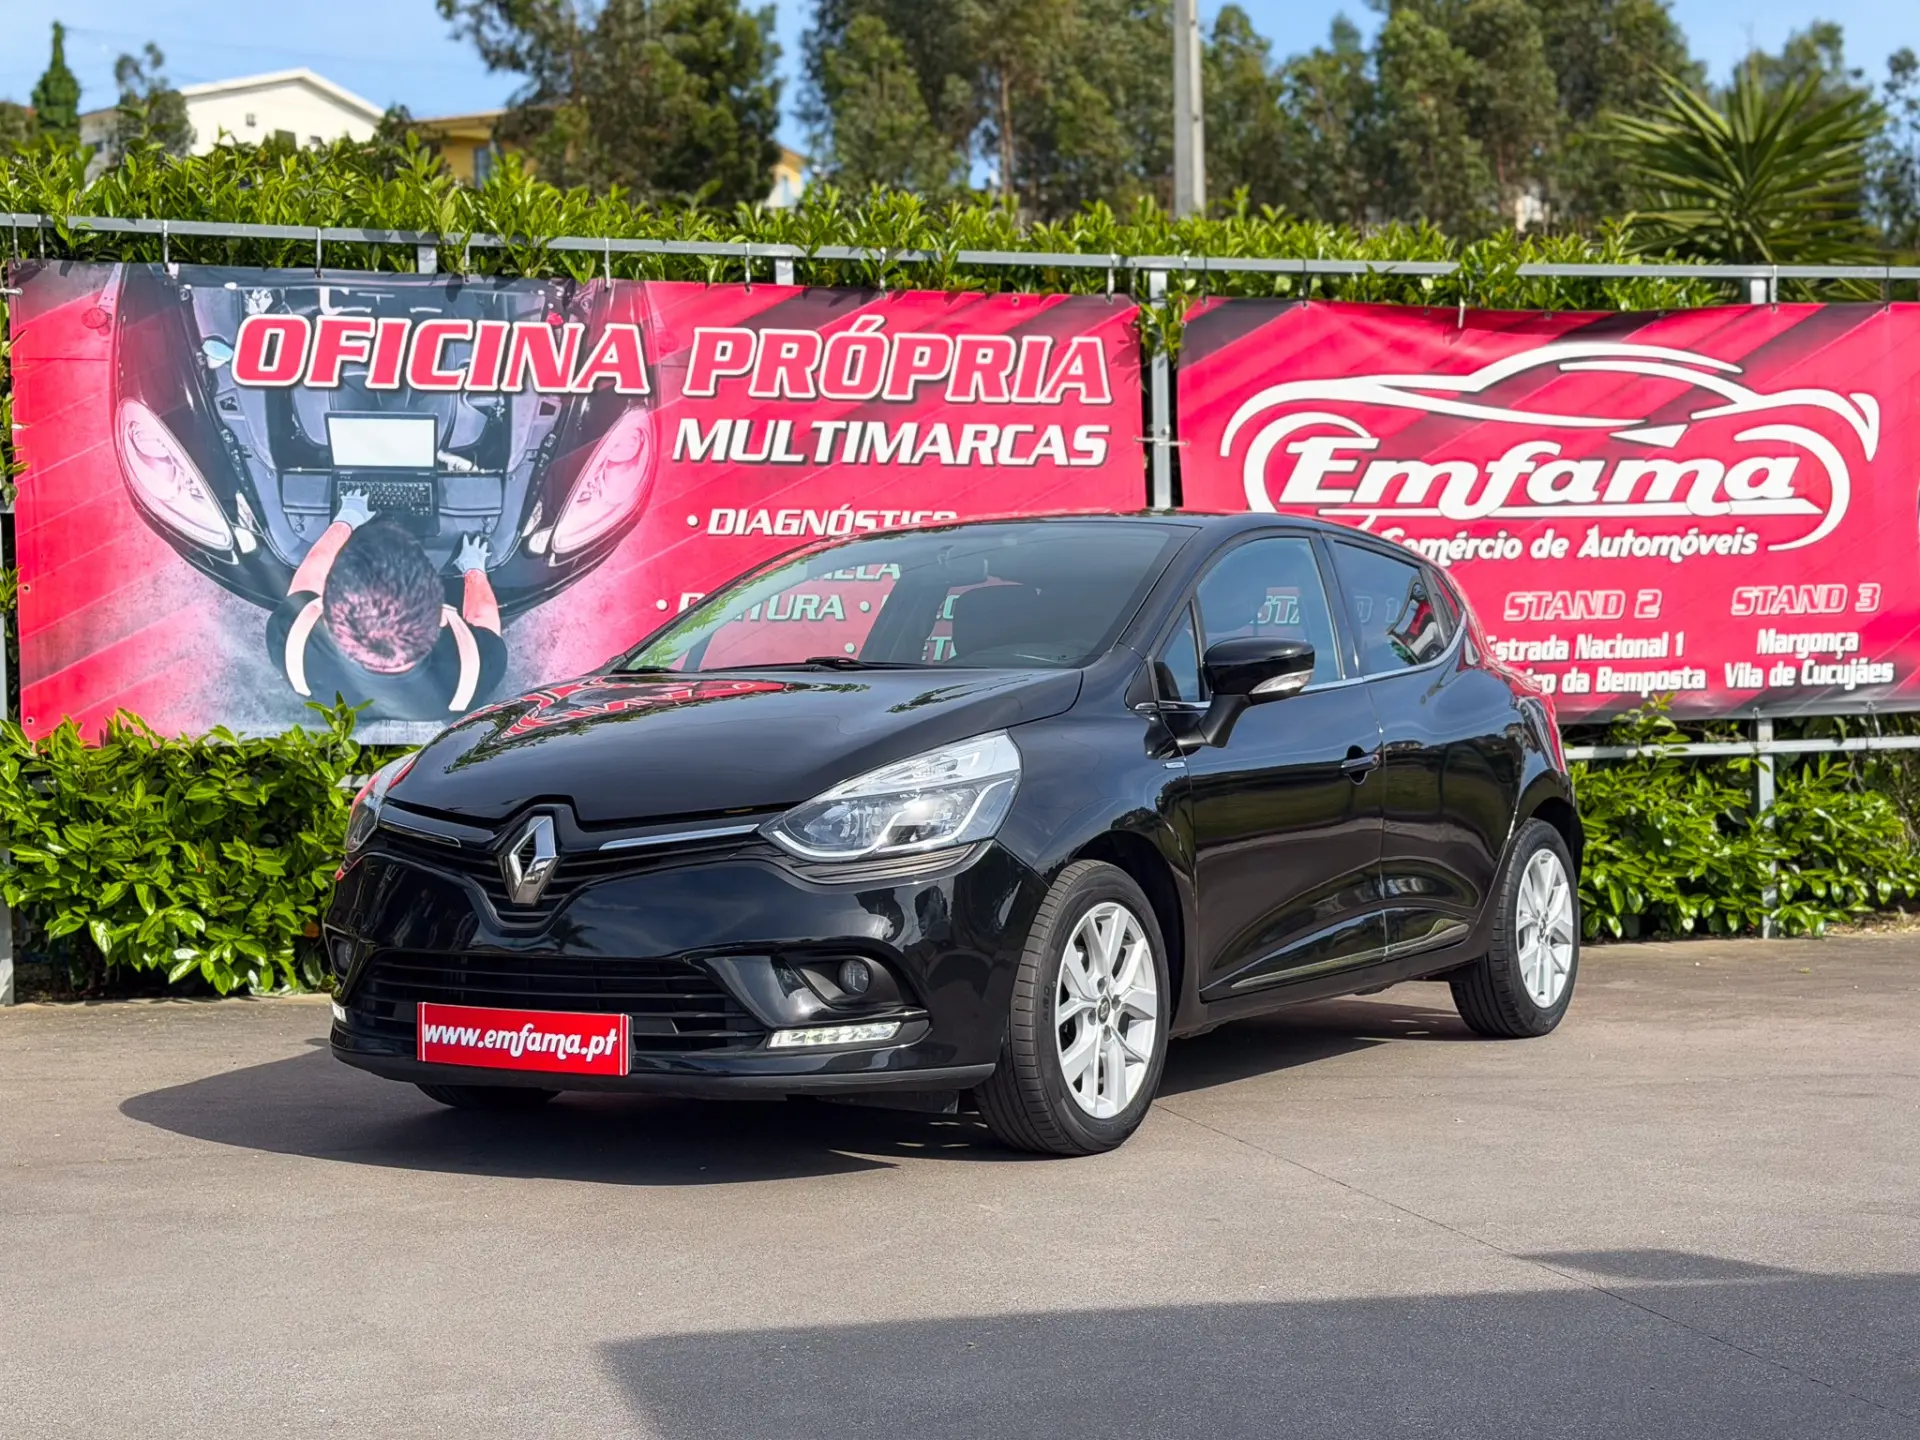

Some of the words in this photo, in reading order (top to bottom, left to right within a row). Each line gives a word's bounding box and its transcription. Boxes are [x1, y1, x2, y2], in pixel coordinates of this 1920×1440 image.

[231, 314, 650, 394] OFICINA
[682, 314, 1113, 404] PRÓPRIA
[672, 418, 1110, 466] MULTIMARCAS
[1279, 436, 1799, 520] Emfama
[1530, 528, 1569, 559] de
[1577, 523, 1758, 564] Automóveis
[1503, 590, 1626, 622] STAND
[1634, 589, 1662, 619] 2
[1731, 585, 1848, 616] STAND
[1855, 583, 1881, 612] 3
[1575, 632, 1669, 660] Nacional
[1675, 631, 1685, 657] 1
[1756, 628, 1859, 660] Margonça
[1562, 667, 1590, 693] da
[1596, 666, 1706, 698] Bemposta
[1724, 661, 1764, 689] Vila
[1769, 661, 1796, 687] de
[1801, 657, 1894, 691] Cucujães
[424, 1023, 618, 1062] www.emfama.pt
